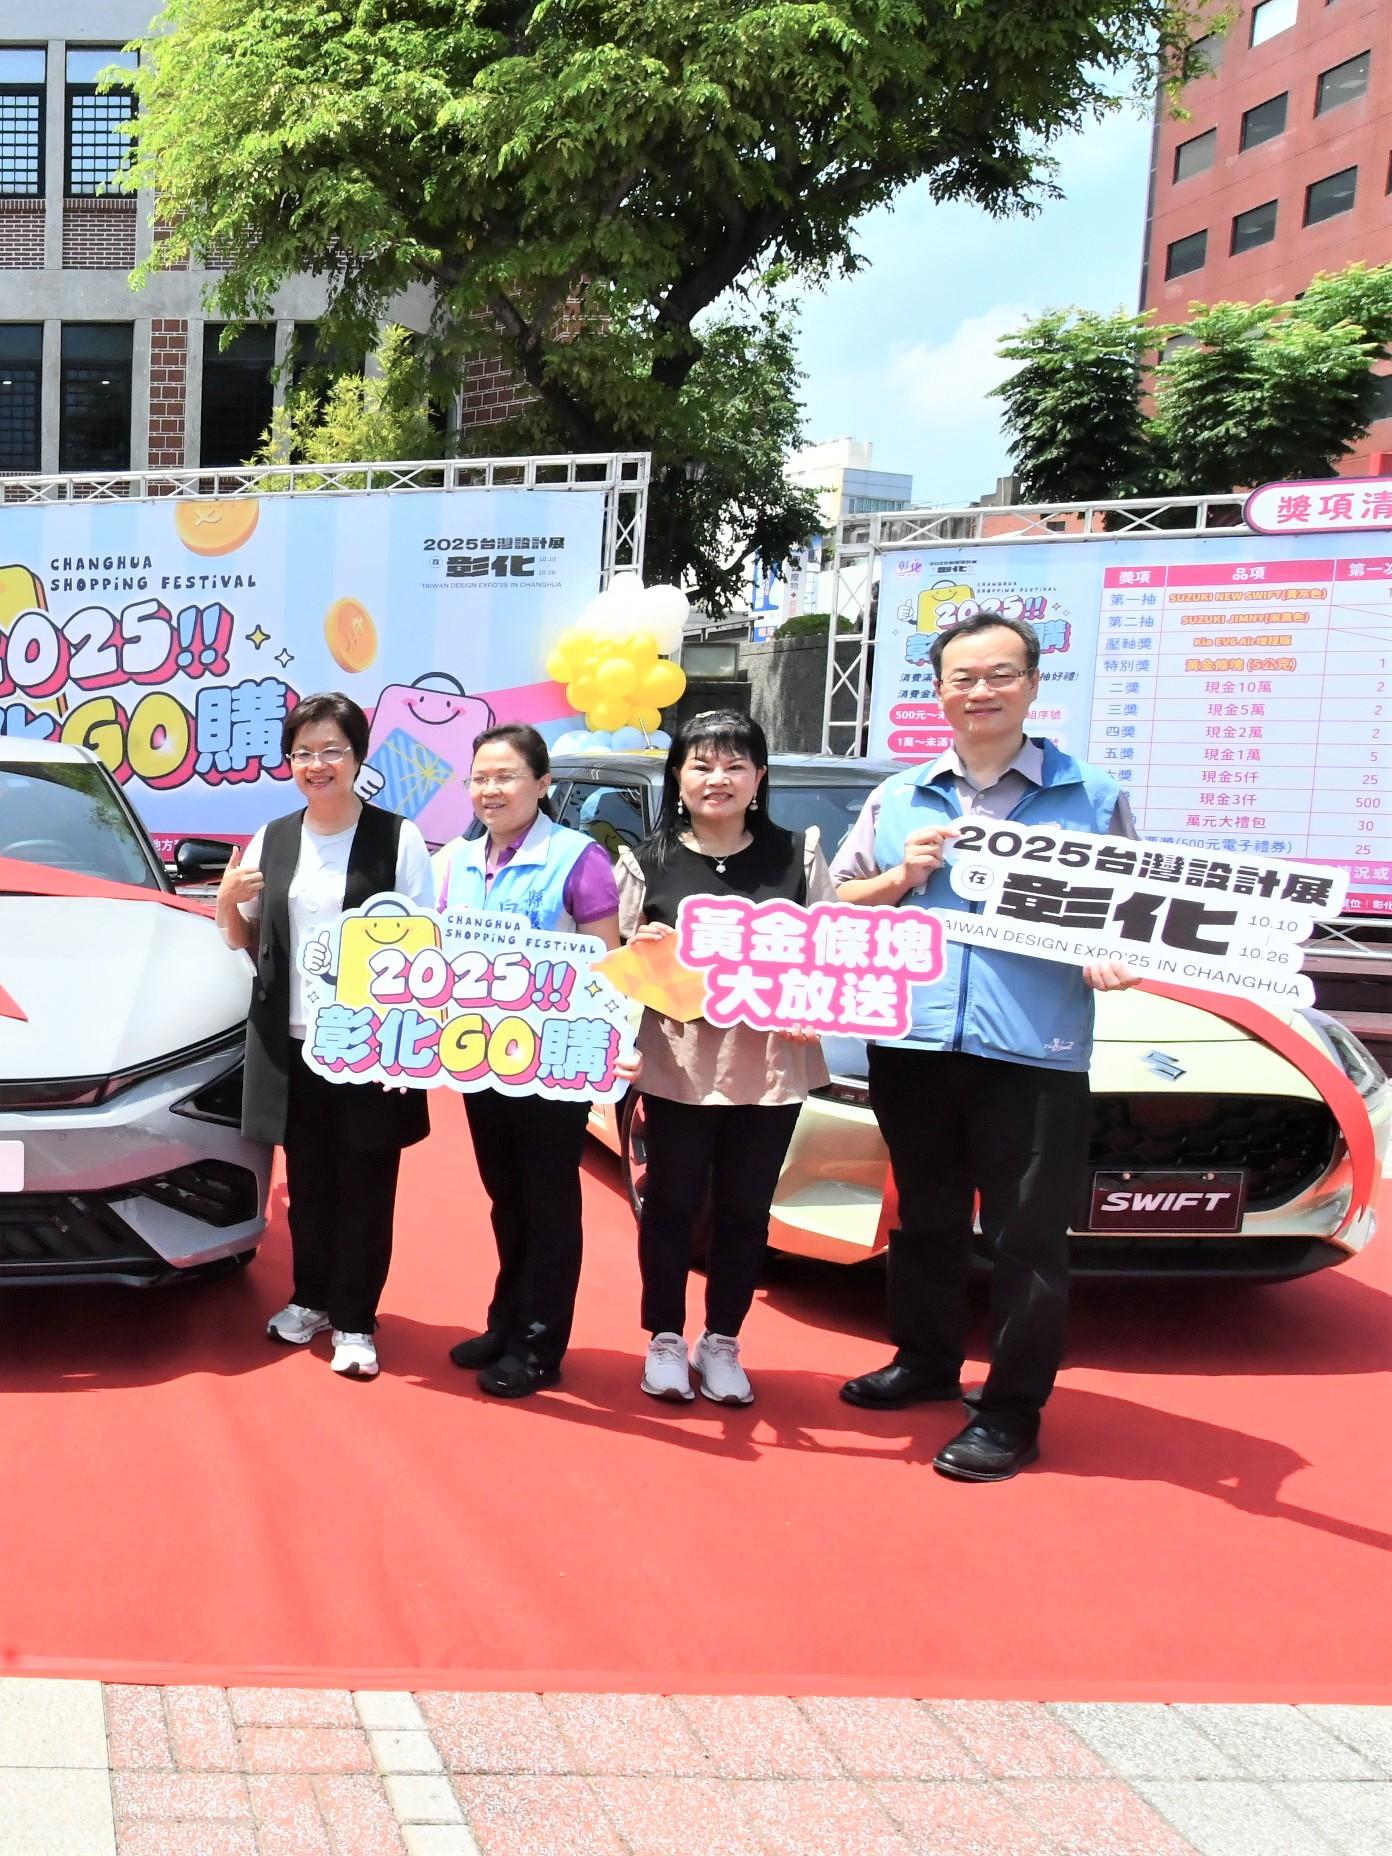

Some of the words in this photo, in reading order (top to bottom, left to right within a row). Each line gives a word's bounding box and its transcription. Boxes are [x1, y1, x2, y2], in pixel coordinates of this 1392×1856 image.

[423, 537, 565, 551] 2025台灣設計展
[50, 555, 153, 571] CHANGHUA
[446, 555, 535, 577] 彰化
[1119, 570, 1151, 584] 獎項
[1232, 566, 1266, 580] 品項
[1110, 593, 1156, 606] 第一抽
[1169, 592, 1213, 603] SUZUKI
[1214, 591, 1243, 602] NEW
[1109, 614, 1153, 628] 第二抽
[1181, 614, 1226, 625] SUZUKI
[1104, 660, 1150, 672] 特別獎
[1205, 681, 1272, 693] 現金10萬
[1376, 682, 1385, 692] 2
[1208, 703, 1266, 716] 現金5萬
[1374, 705, 1382, 715] 2
[1206, 726, 1263, 739] 現金2萬
[1372, 728, 1380, 739] 2
[1203, 749, 1261, 761] 現金1萬
[1370, 751, 1378, 762] 5
[1202, 770, 1259, 783] 現金5仟
[1362, 775, 1378, 785] 25
[1199, 793, 1257, 806] 現金3仟
[1356, 797, 1381, 808] 500
[1186, 815, 1266, 829] 萬元大禮包
[1358, 820, 1374, 831] 30
[1355, 845, 1371, 855] 25
[952, 824, 1335, 908] 2025台灣設計展
[968, 869, 987, 886] 在
[995, 871, 1239, 957] 彰化
[447, 914, 522, 932] CHANGHUA
[1248, 914, 1299, 933] 10.10
[944, 918, 999, 940] AIWAN
[1003, 929, 1069, 953] DESIGN
[1157, 959, 1178, 975] IN
[1183, 964, 1301, 998] CHANGHUA
[1239, 945, 1290, 965] 10.26
[368, 948, 577, 1013] 2025!!
[716, 965, 899, 1028] 大放送
[311, 1003, 622, 1093] 彰化GO購
[1100, 1191, 1232, 1213] SWIFT
